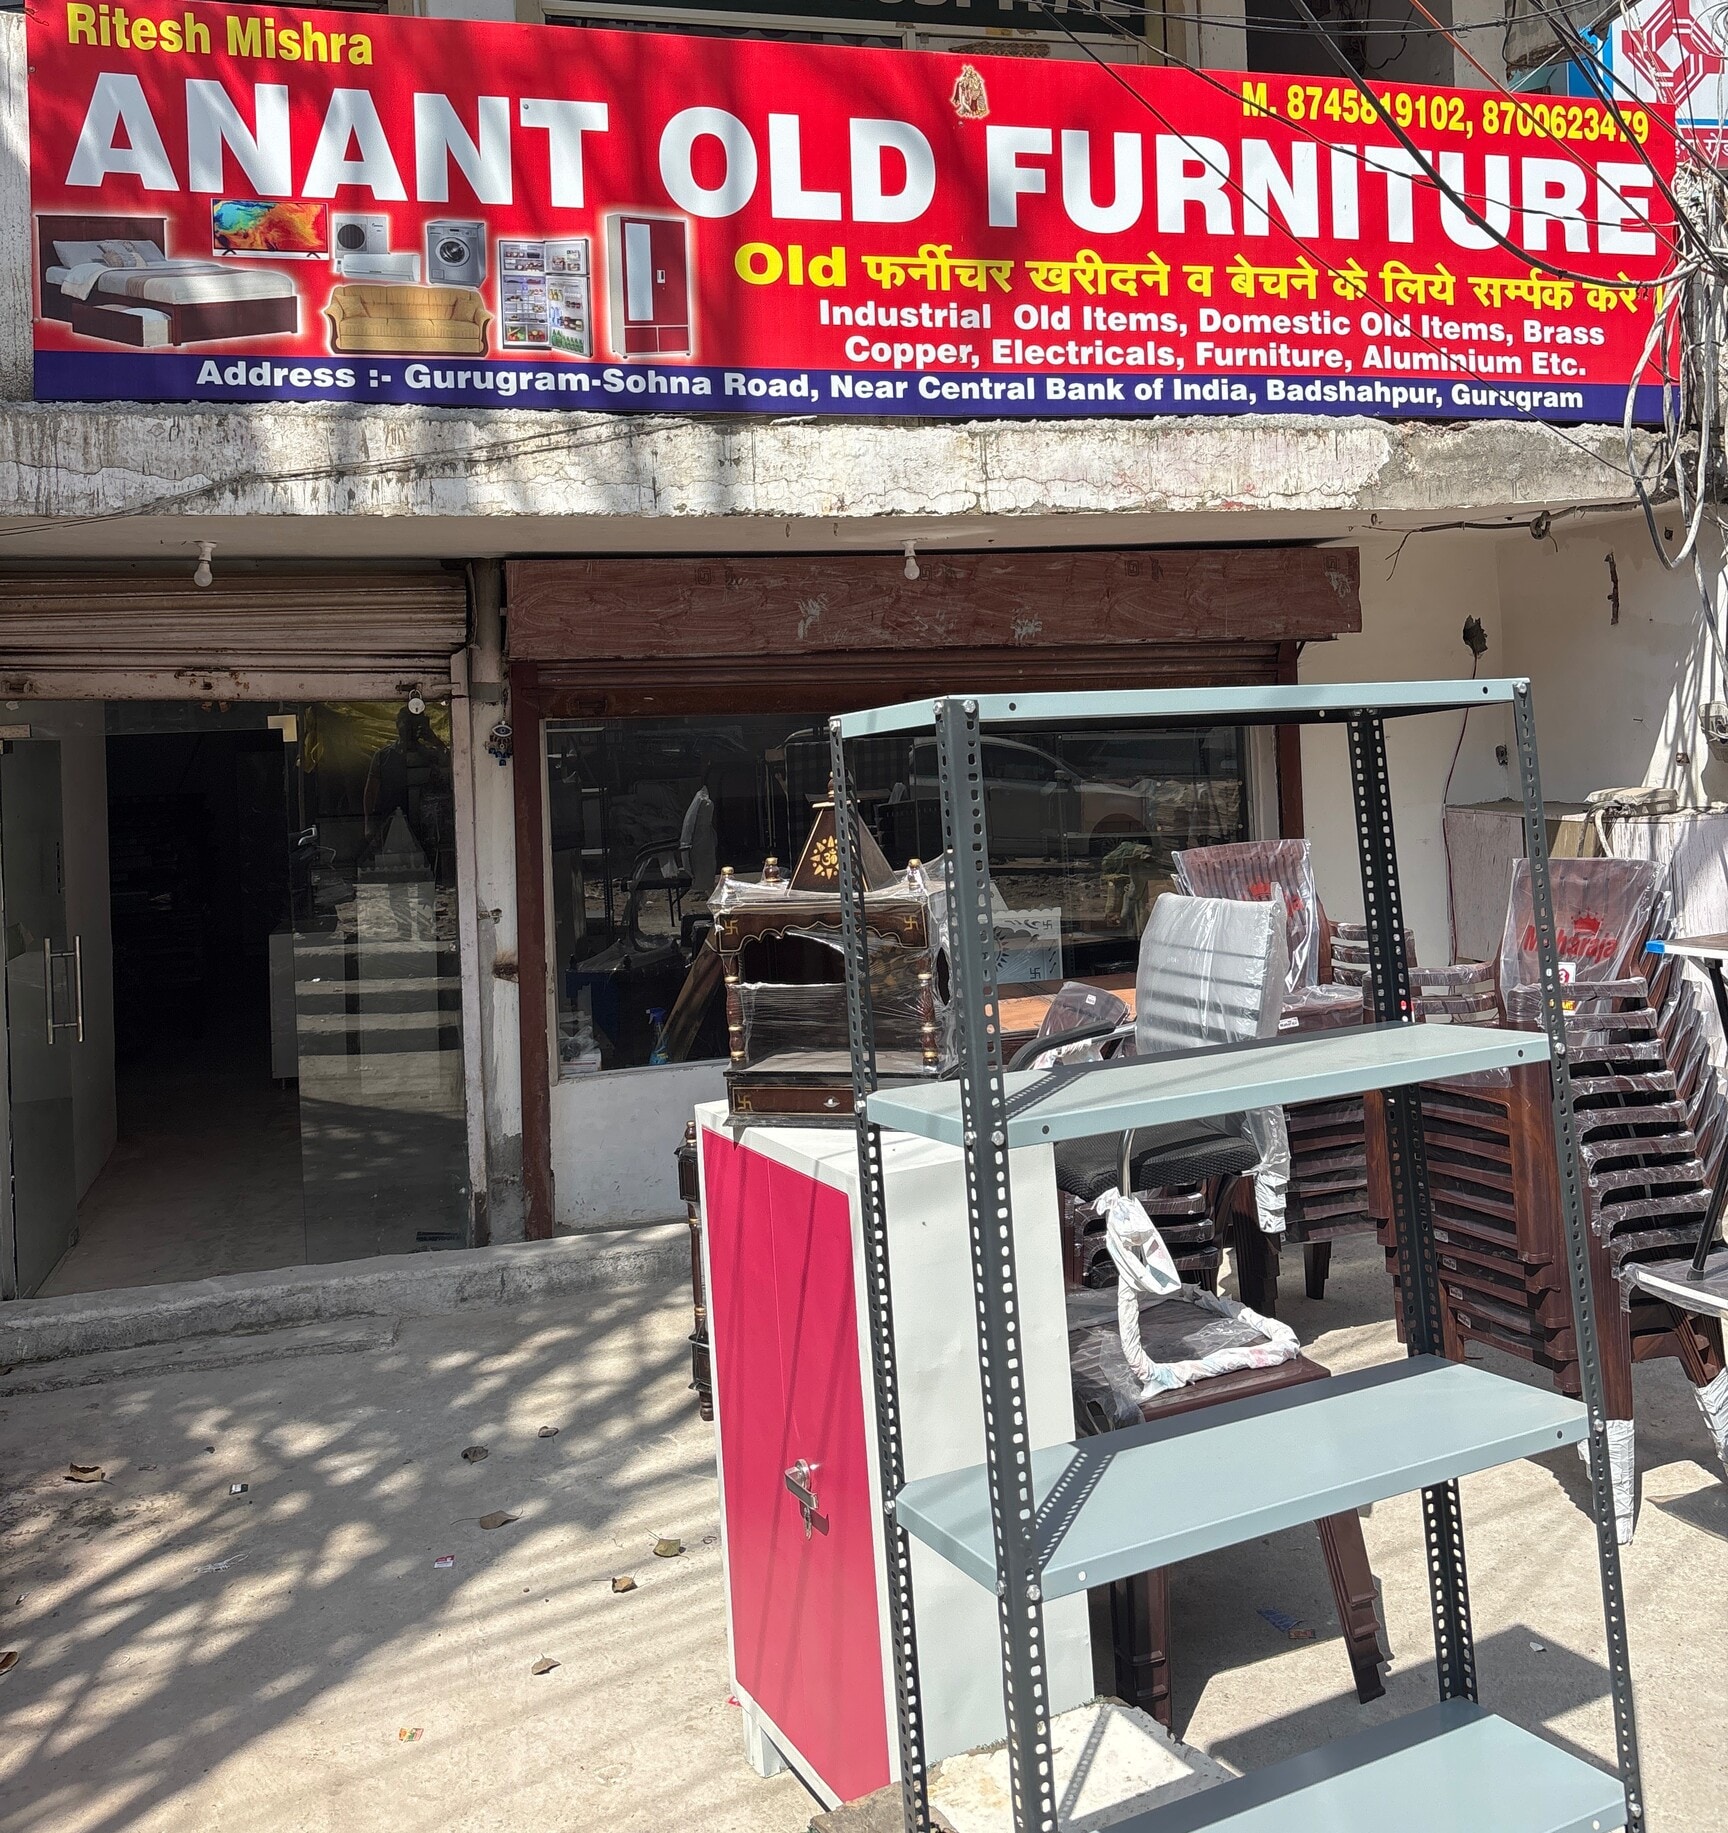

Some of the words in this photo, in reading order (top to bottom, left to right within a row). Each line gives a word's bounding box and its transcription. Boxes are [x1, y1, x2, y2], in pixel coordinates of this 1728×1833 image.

[66, 2, 211, 54] Ritesh
[226, 15, 373, 65] Mishra
[1242, 81, 1277, 118] M.
[64, 71, 609, 209] ANANT
[658, 106, 936, 223] OLD
[986, 125, 1656, 256] FURNITURE
[734, 242, 847, 288] Old
[860, 243, 1015, 293] फर्नीचर
[1024, 248, 1171, 297] खरीदने
[1181, 265, 1214, 298] व
[1228, 253, 1319, 300] बेचने
[1327, 257, 1369, 301] के
[1378, 260, 1457, 306] लिये
[819, 299, 991, 329] Industrial
[1013, 303, 1071, 331] Old
[1083, 305, 1188, 338] Items,
[1199, 307, 1351, 336] Domestic
[1360, 311, 1411, 338] Old
[1421, 314, 1514, 346] Items,
[1523, 319, 1605, 346] Brass
[844, 335, 980, 370] Copper,
[992, 338, 1185, 371] Electricals,
[1196, 341, 1353, 373] Furniture,
[1362, 343, 1522, 374] Aluminium
[1531, 351, 1586, 376] Etc.
[196, 360, 356, 388] Address
[369, 369, 392, 388] :-
[404, 361, 712, 397] Gurugram-Sohna
[724, 372, 819, 403] Road,
[830, 374, 909, 399] Near
[918, 375, 1035, 401] Central
[1049, 377, 1126, 401] Bank
[1134, 377, 1164, 401] of
[1173, 378, 1257, 406] India,
[1266, 378, 1443, 409] Badshahpur,
[1451, 383, 1584, 411] Gurugram
[1523, 925, 1617, 963] Mharaja
